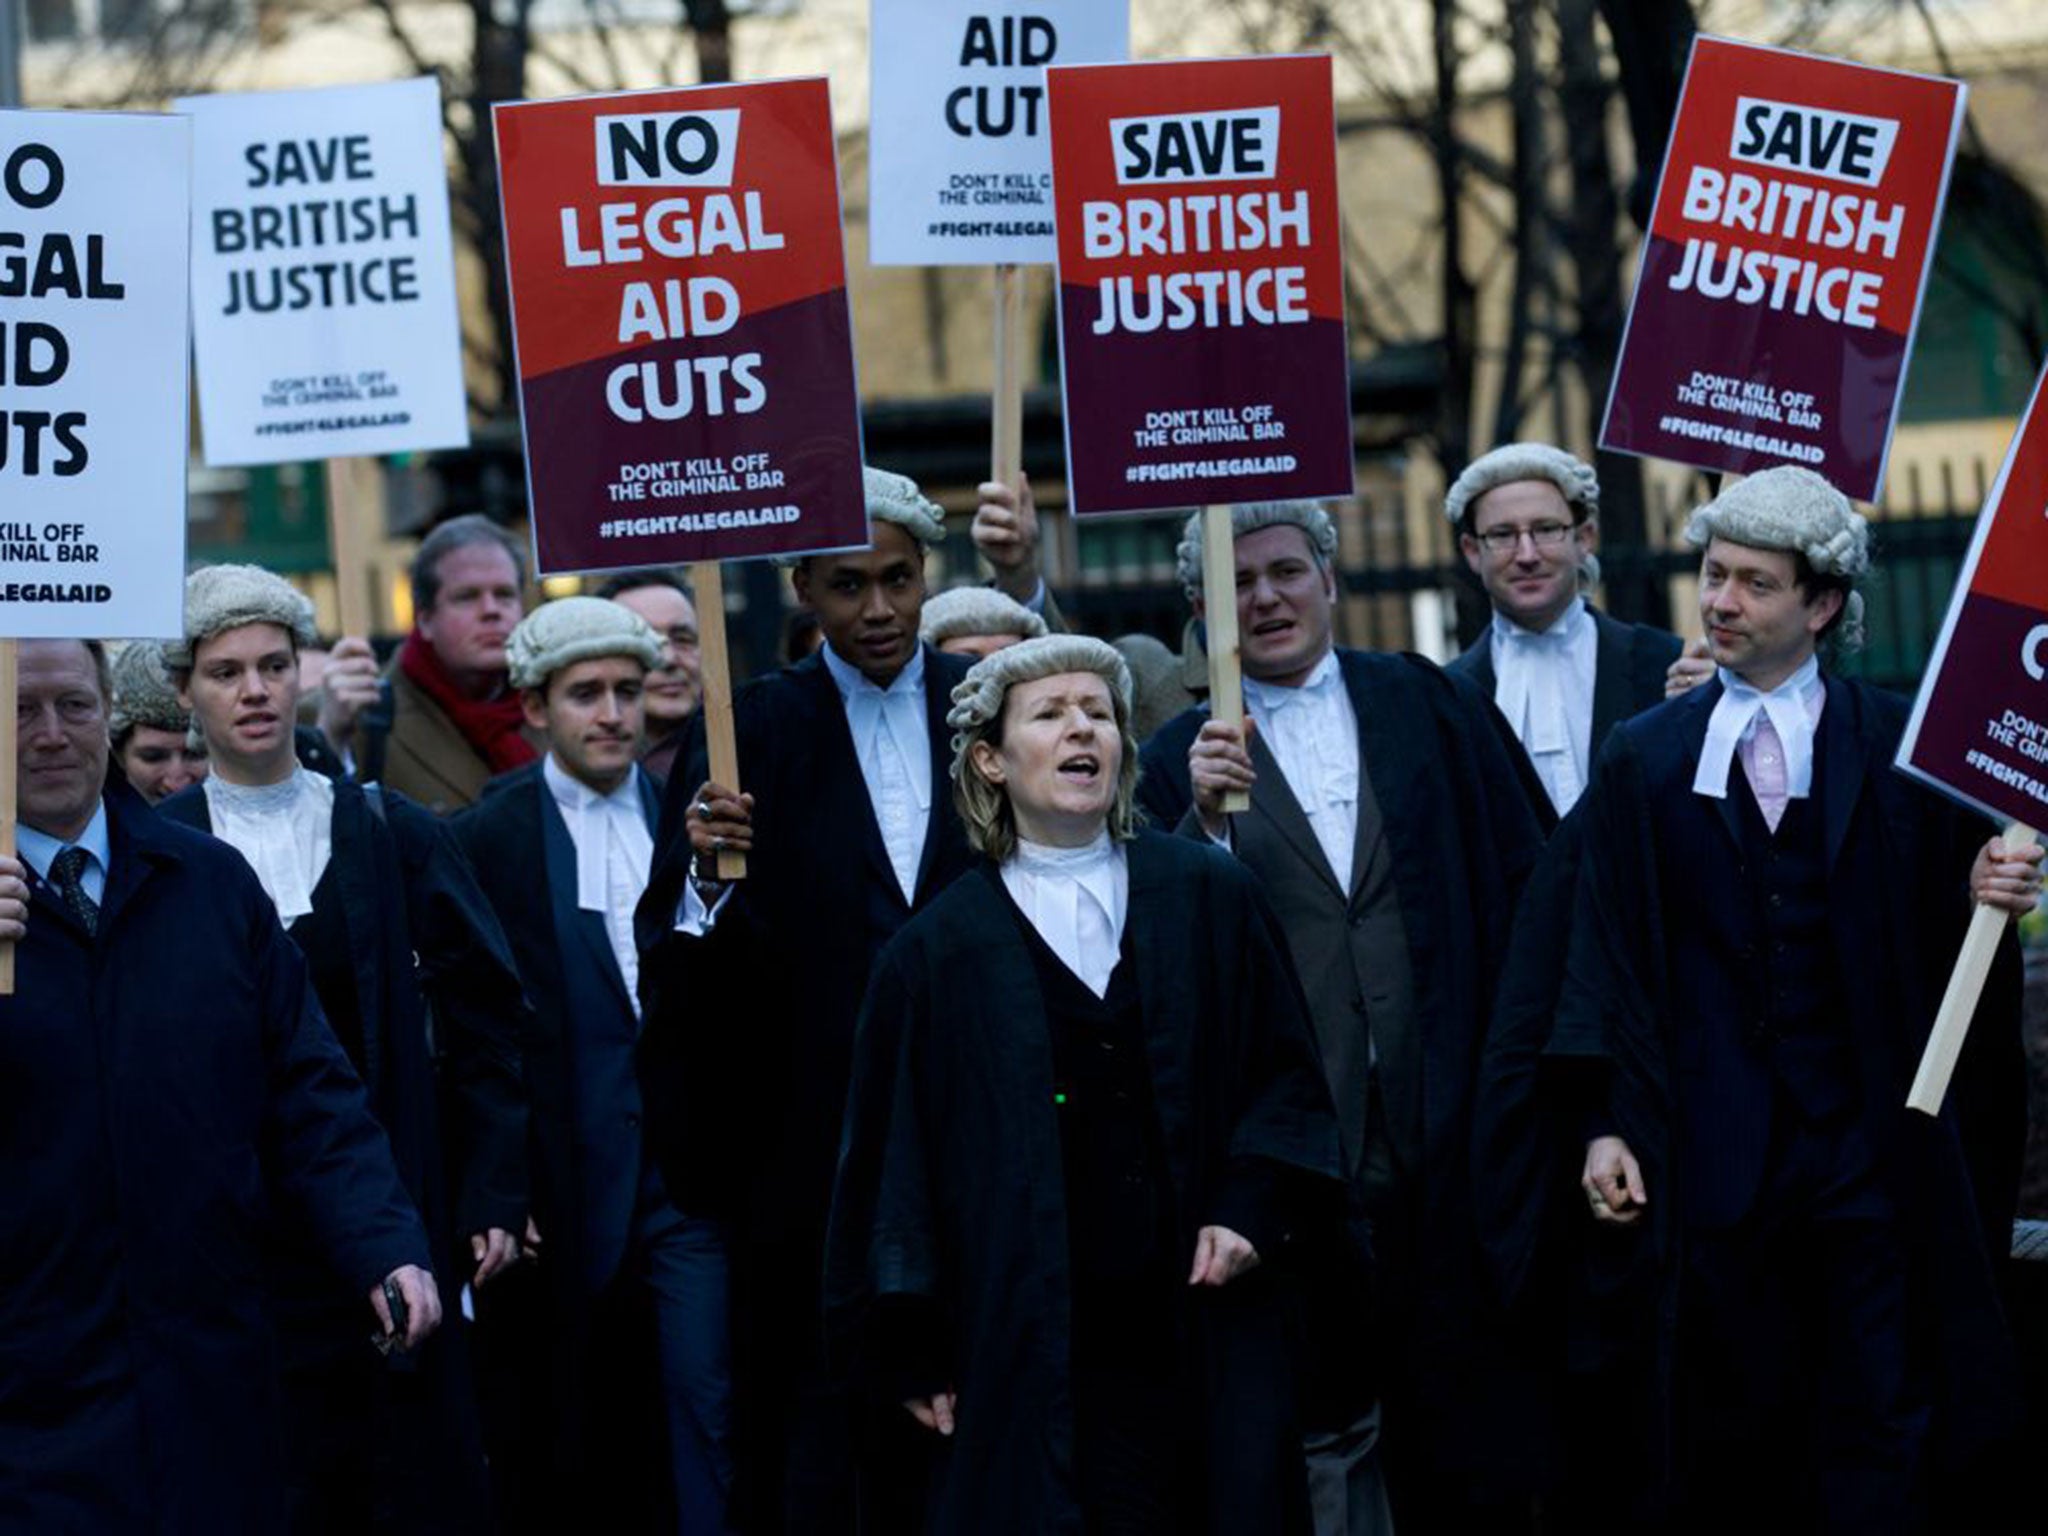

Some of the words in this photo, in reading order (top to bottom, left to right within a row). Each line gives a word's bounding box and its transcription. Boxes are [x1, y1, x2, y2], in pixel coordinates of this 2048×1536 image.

[960, 16, 1057, 66] AID
[945, 86, 1043, 137] CUT
[244, 136, 374, 188] SAVE
[609, 116, 719, 181] NO
[1122, 117, 1264, 180] SAVE
[1739, 106, 1877, 178] SAVE
[4, 143, 64, 209] O
[939, 190, 968, 204] THE
[973, 190, 1044, 204] CRIMINAL
[950, 174, 998, 189] DON'T
[1004, 174, 1035, 188] KILL
[213, 194, 418, 254] BRITISH
[560, 191, 784, 267] LEGAL
[1082, 189, 1311, 258] BRITISH
[1681, 165, 1905, 259] BRITISH
[0, 233, 125, 299] GAL
[223, 257, 419, 316] JUSTICE
[1668, 238, 1883, 329] JUSTICE
[618, 276, 740, 343] AID
[1092, 266, 1310, 335] JUSTICE
[606, 352, 767, 422] CUTS
[1677, 385, 1707, 406] THE
[1710, 393, 1783, 422] CRIMINAL
[1787, 408, 1822, 430] BAR
[1691, 371, 1741, 394] DON'T
[1743, 382, 1776, 404] KILL
[1780, 390, 1814, 410] OFF
[1134, 429, 1168, 447] THE
[1172, 425, 1249, 444] CRIMINAL
[1253, 422, 1285, 439] BAR
[1145, 410, 1200, 429] DON'T
[1203, 408, 1238, 425] KILL
[1242, 405, 1273, 423] OFF
[1659, 415, 1825, 463] #FIGHT4LEGALAID
[0, 411, 88, 476] TS
[620, 461, 680, 482] DON'T
[686, 458, 727, 477] KILL
[732, 453, 769, 473] OFF
[1126, 455, 1297, 482] #FIGHT4LEGALAID
[608, 482, 646, 501] THE
[650, 474, 740, 498] CRIMINAL
[746, 470, 785, 490] BAR
[43, 523, 85, 542] OFF
[599, 505, 801, 538] #FIGHT4LEGALAID
[2, 543, 51, 562] INAL
[57, 544, 99, 562] BAR
[0, 584, 112, 602] EGALAID
[1986, 719, 2017, 749] THE
[1965, 748, 2048, 805] #FIGHT4L
